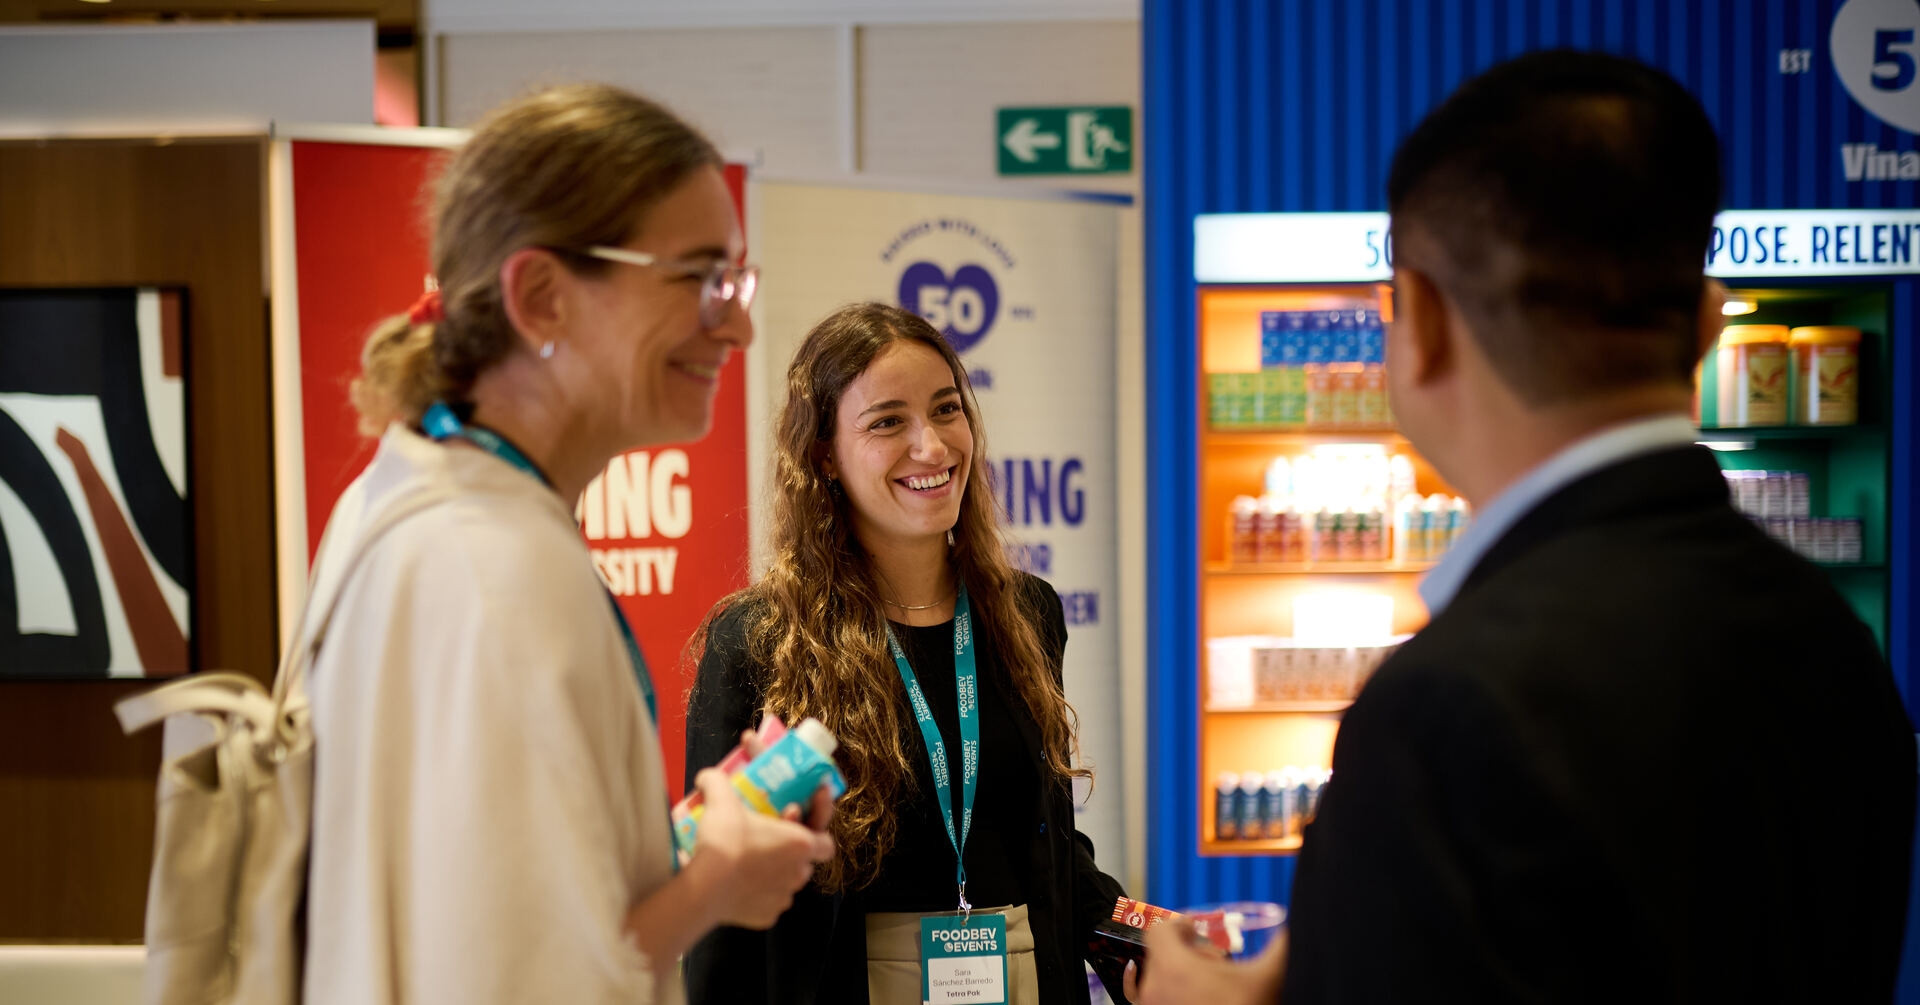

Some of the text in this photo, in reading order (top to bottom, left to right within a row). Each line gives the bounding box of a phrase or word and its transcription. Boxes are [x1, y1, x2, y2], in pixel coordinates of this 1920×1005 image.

[1779, 50, 1811, 74] EST
[1812, 223, 1920, 264] RELEN
[918, 285, 986, 335] 50
[575, 448, 692, 540] ING
[955, 615, 964, 655] FOODBEV
[910, 679, 931, 721] FOODBEV
[958, 675, 968, 718] FOODBEV
[966, 674, 975, 704] EVENTS
[911, 692, 926, 722] EVENTS
[932, 759, 944, 789] EVENTS
[935, 741, 949, 786] FOODBEV
[963, 739, 971, 784] FOODBEV
[931, 927, 997, 942] FOODBEV
[953, 940, 998, 952] EVENTS
[954, 968, 971, 977] Sara
[946, 989, 981, 998] Tetra Pak
